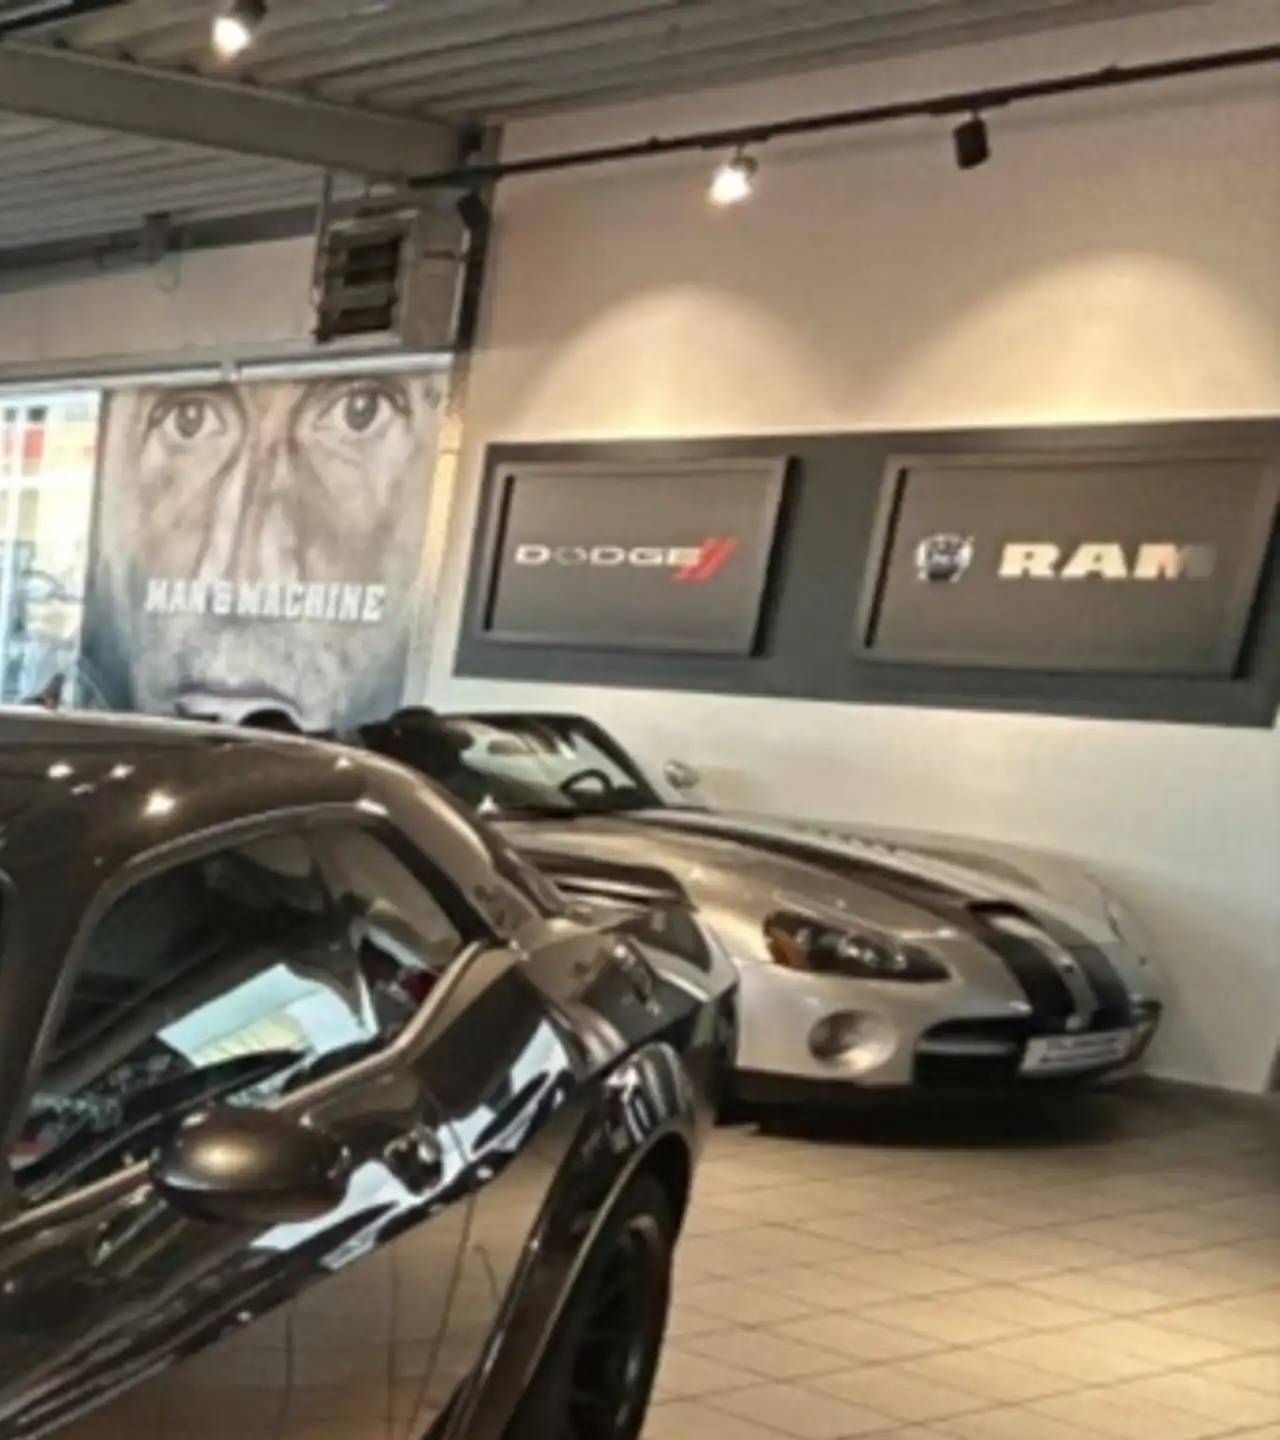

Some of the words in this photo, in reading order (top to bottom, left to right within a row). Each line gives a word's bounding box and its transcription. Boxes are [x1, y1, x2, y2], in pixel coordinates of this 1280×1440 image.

[514, 543, 703, 568] DODGE
[996, 540, 1218, 580] RAM
[144, 577, 208, 615] MAN
[236, 579, 386, 623] MACHINE
